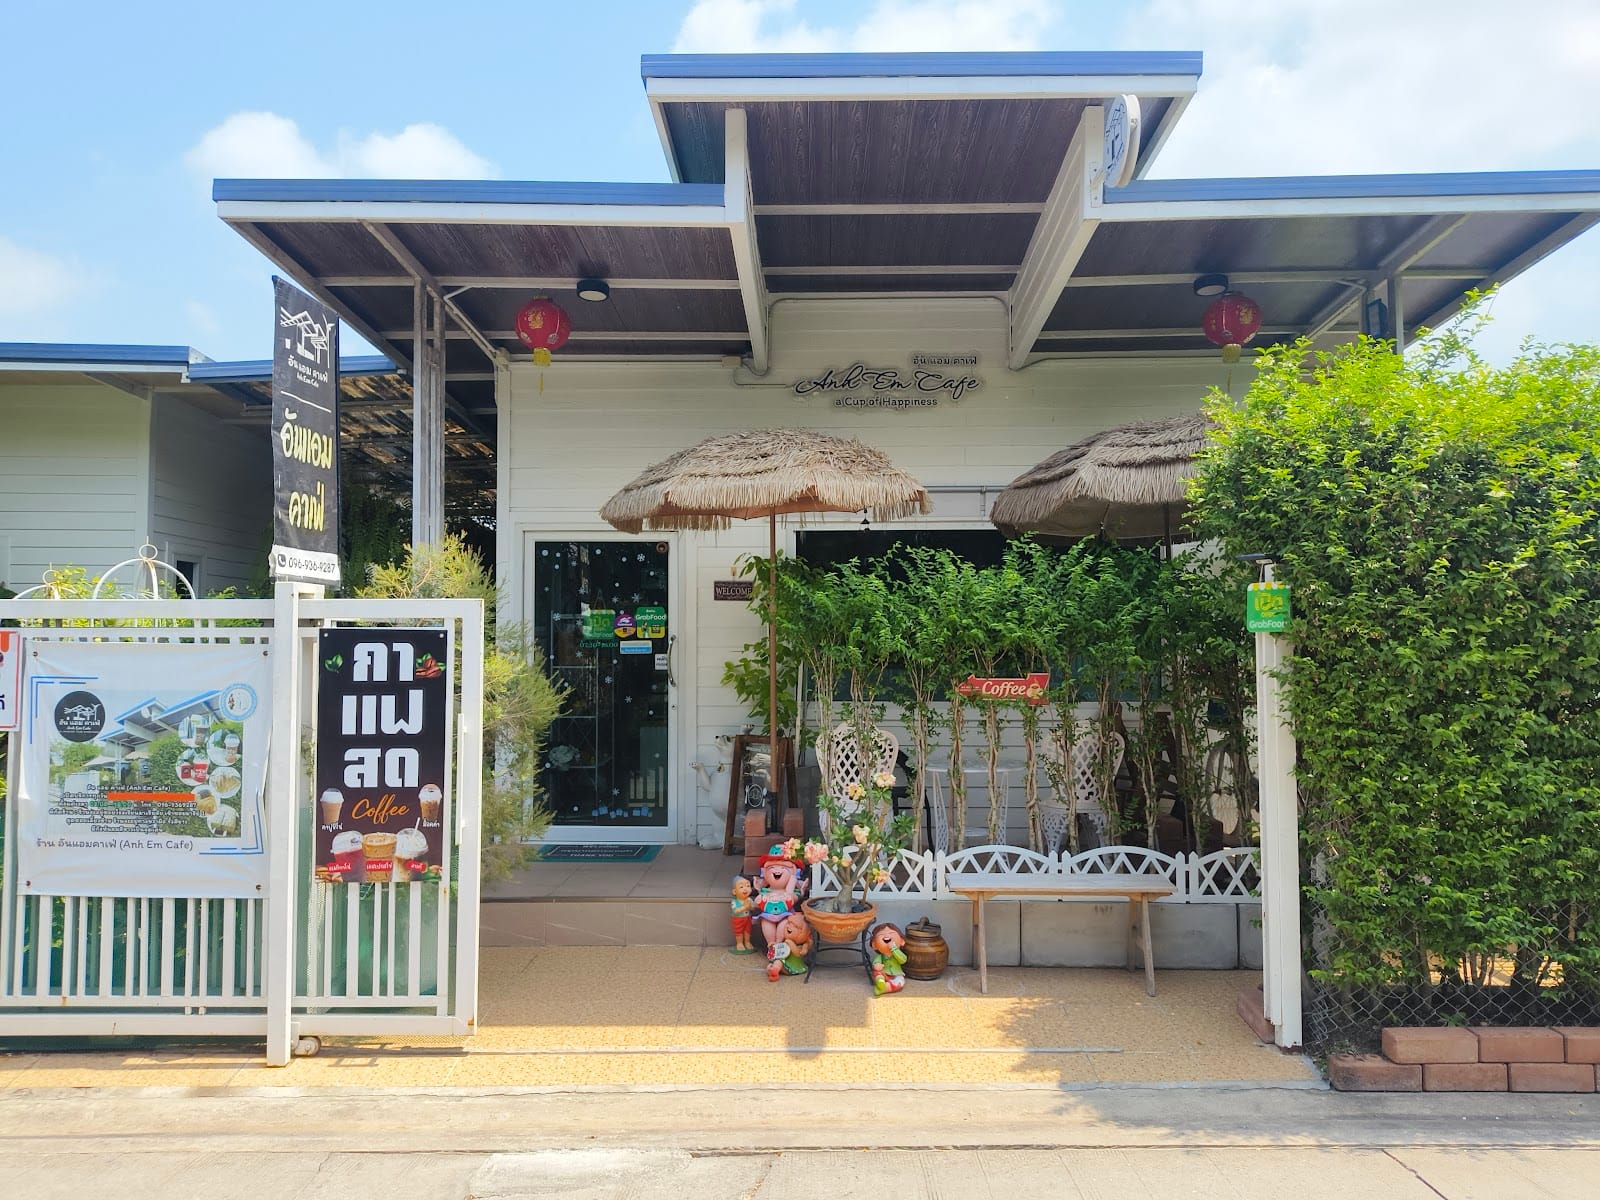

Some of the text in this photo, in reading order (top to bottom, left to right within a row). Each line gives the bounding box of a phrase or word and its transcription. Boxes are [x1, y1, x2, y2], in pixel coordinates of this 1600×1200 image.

[795, 365, 979, 399] Anh Em Cafe
[844, 397, 866, 408] Cup
[868, 397, 880, 406] of
[882, 397, 939, 409] Happiness
[289, 481, 325, 532] คาเฟ่
[288, 557, 336, 574] 096-936-9287
[715, 586, 752, 595] WELCOME
[636, 613, 666, 621] GrabFood
[982, 681, 1027, 698] Coffee
[341, 689, 424, 735] แฟ
[343, 748, 420, 788] สด
[352, 793, 410, 824] Coffee
[119, 839, 144, 851] (Anh
[147, 840, 163, 849] Em
[165, 839, 193, 851] Cafe)
